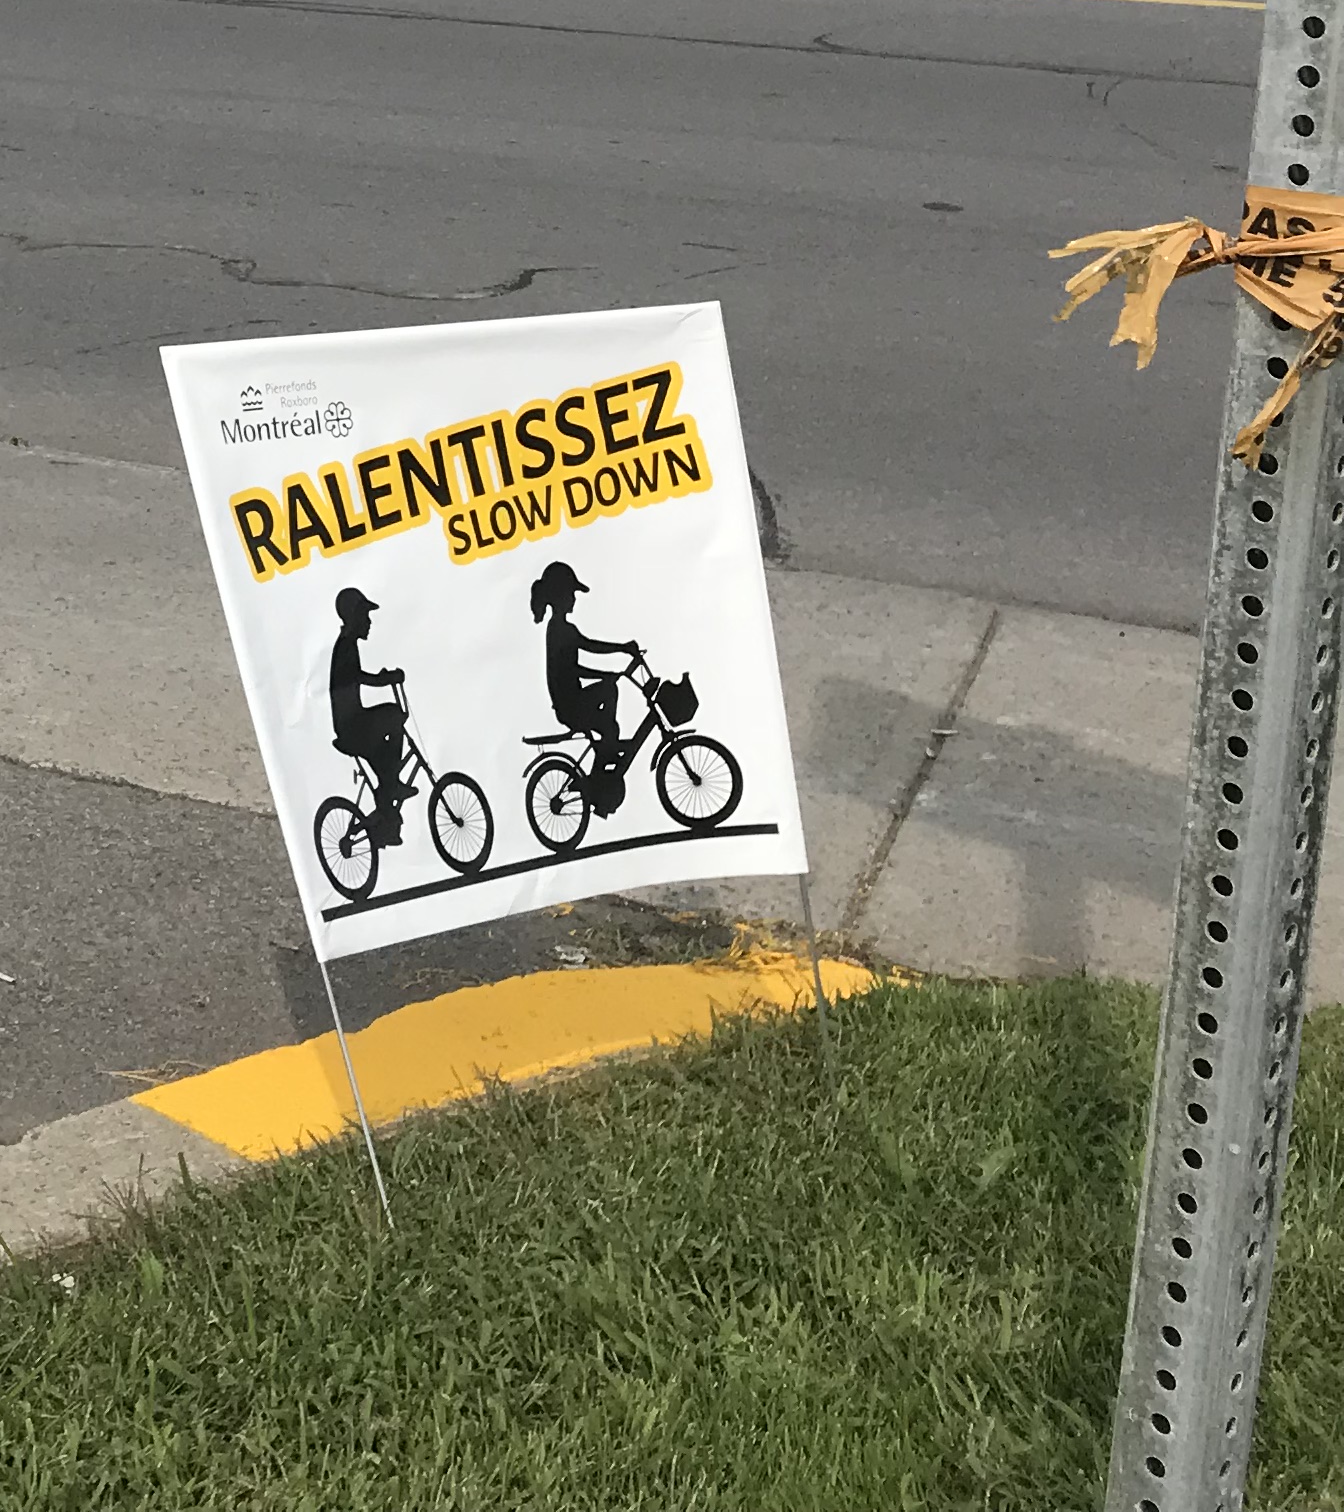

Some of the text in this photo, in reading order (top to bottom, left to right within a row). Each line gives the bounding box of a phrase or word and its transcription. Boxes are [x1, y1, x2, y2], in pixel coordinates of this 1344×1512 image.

[265, 380, 317, 395] Pierrefonds
[280, 395, 318, 408] Roxboro
[220, 409, 322, 445] Montréal
[234, 369, 686, 574] RALENTISSEZ
[448, 443, 701, 556] SLOW DOWN
